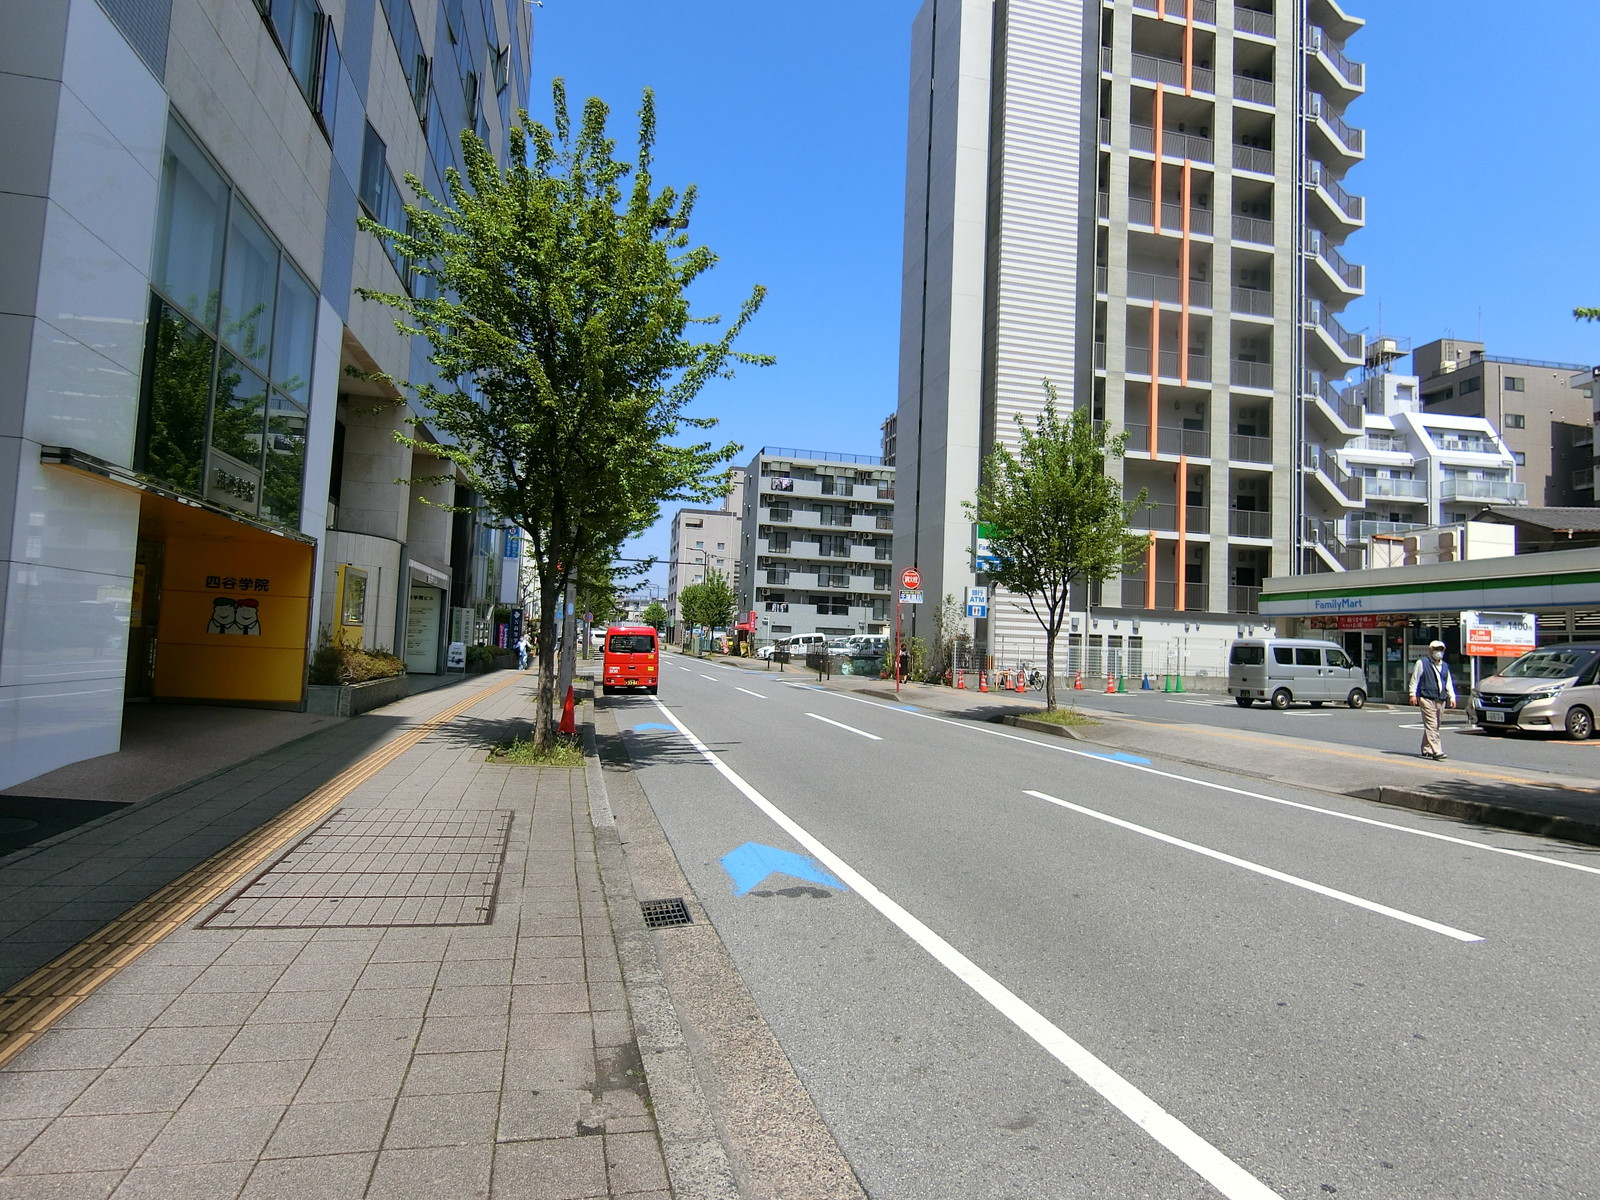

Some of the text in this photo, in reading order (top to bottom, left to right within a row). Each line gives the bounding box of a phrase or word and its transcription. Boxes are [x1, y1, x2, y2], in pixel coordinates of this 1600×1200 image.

[206, 575, 270, 592] 四谷学院
[1315, 599, 1362, 610] FamilyMart
